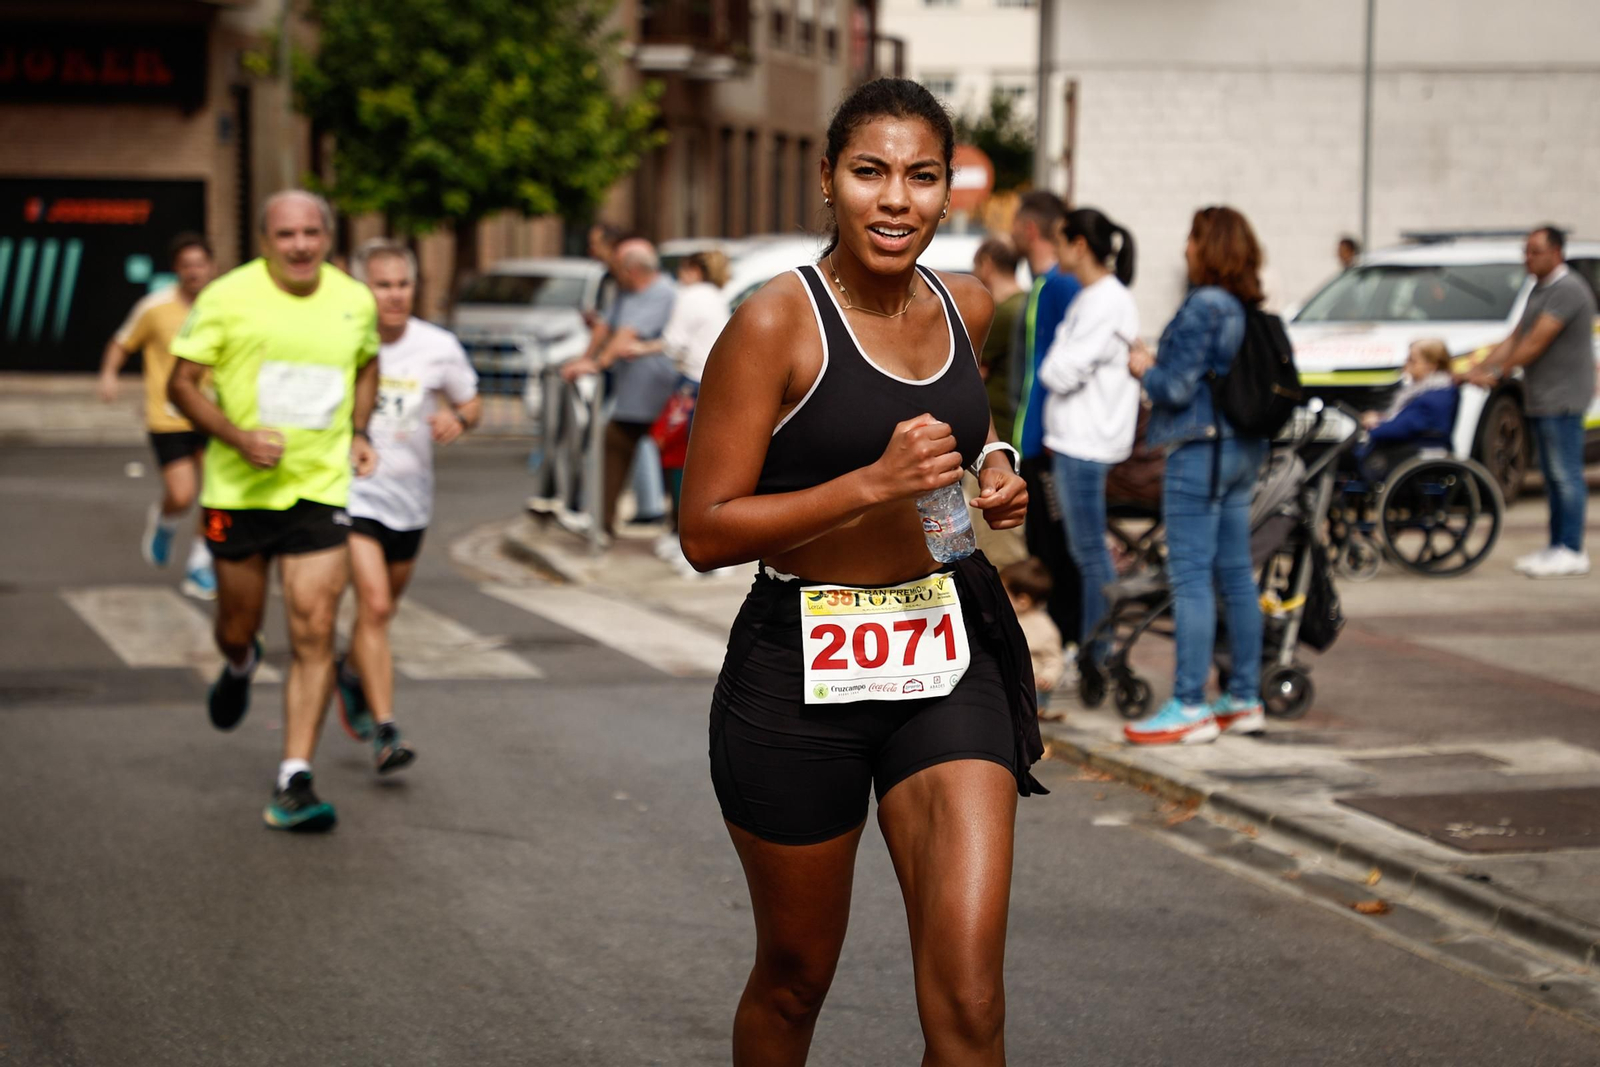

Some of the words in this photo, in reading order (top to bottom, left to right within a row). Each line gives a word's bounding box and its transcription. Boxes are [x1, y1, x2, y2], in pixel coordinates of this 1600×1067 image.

[826, 589, 854, 607] 38
[810, 613, 957, 670] 2071
[830, 684, 867, 693] Cruzcampo
